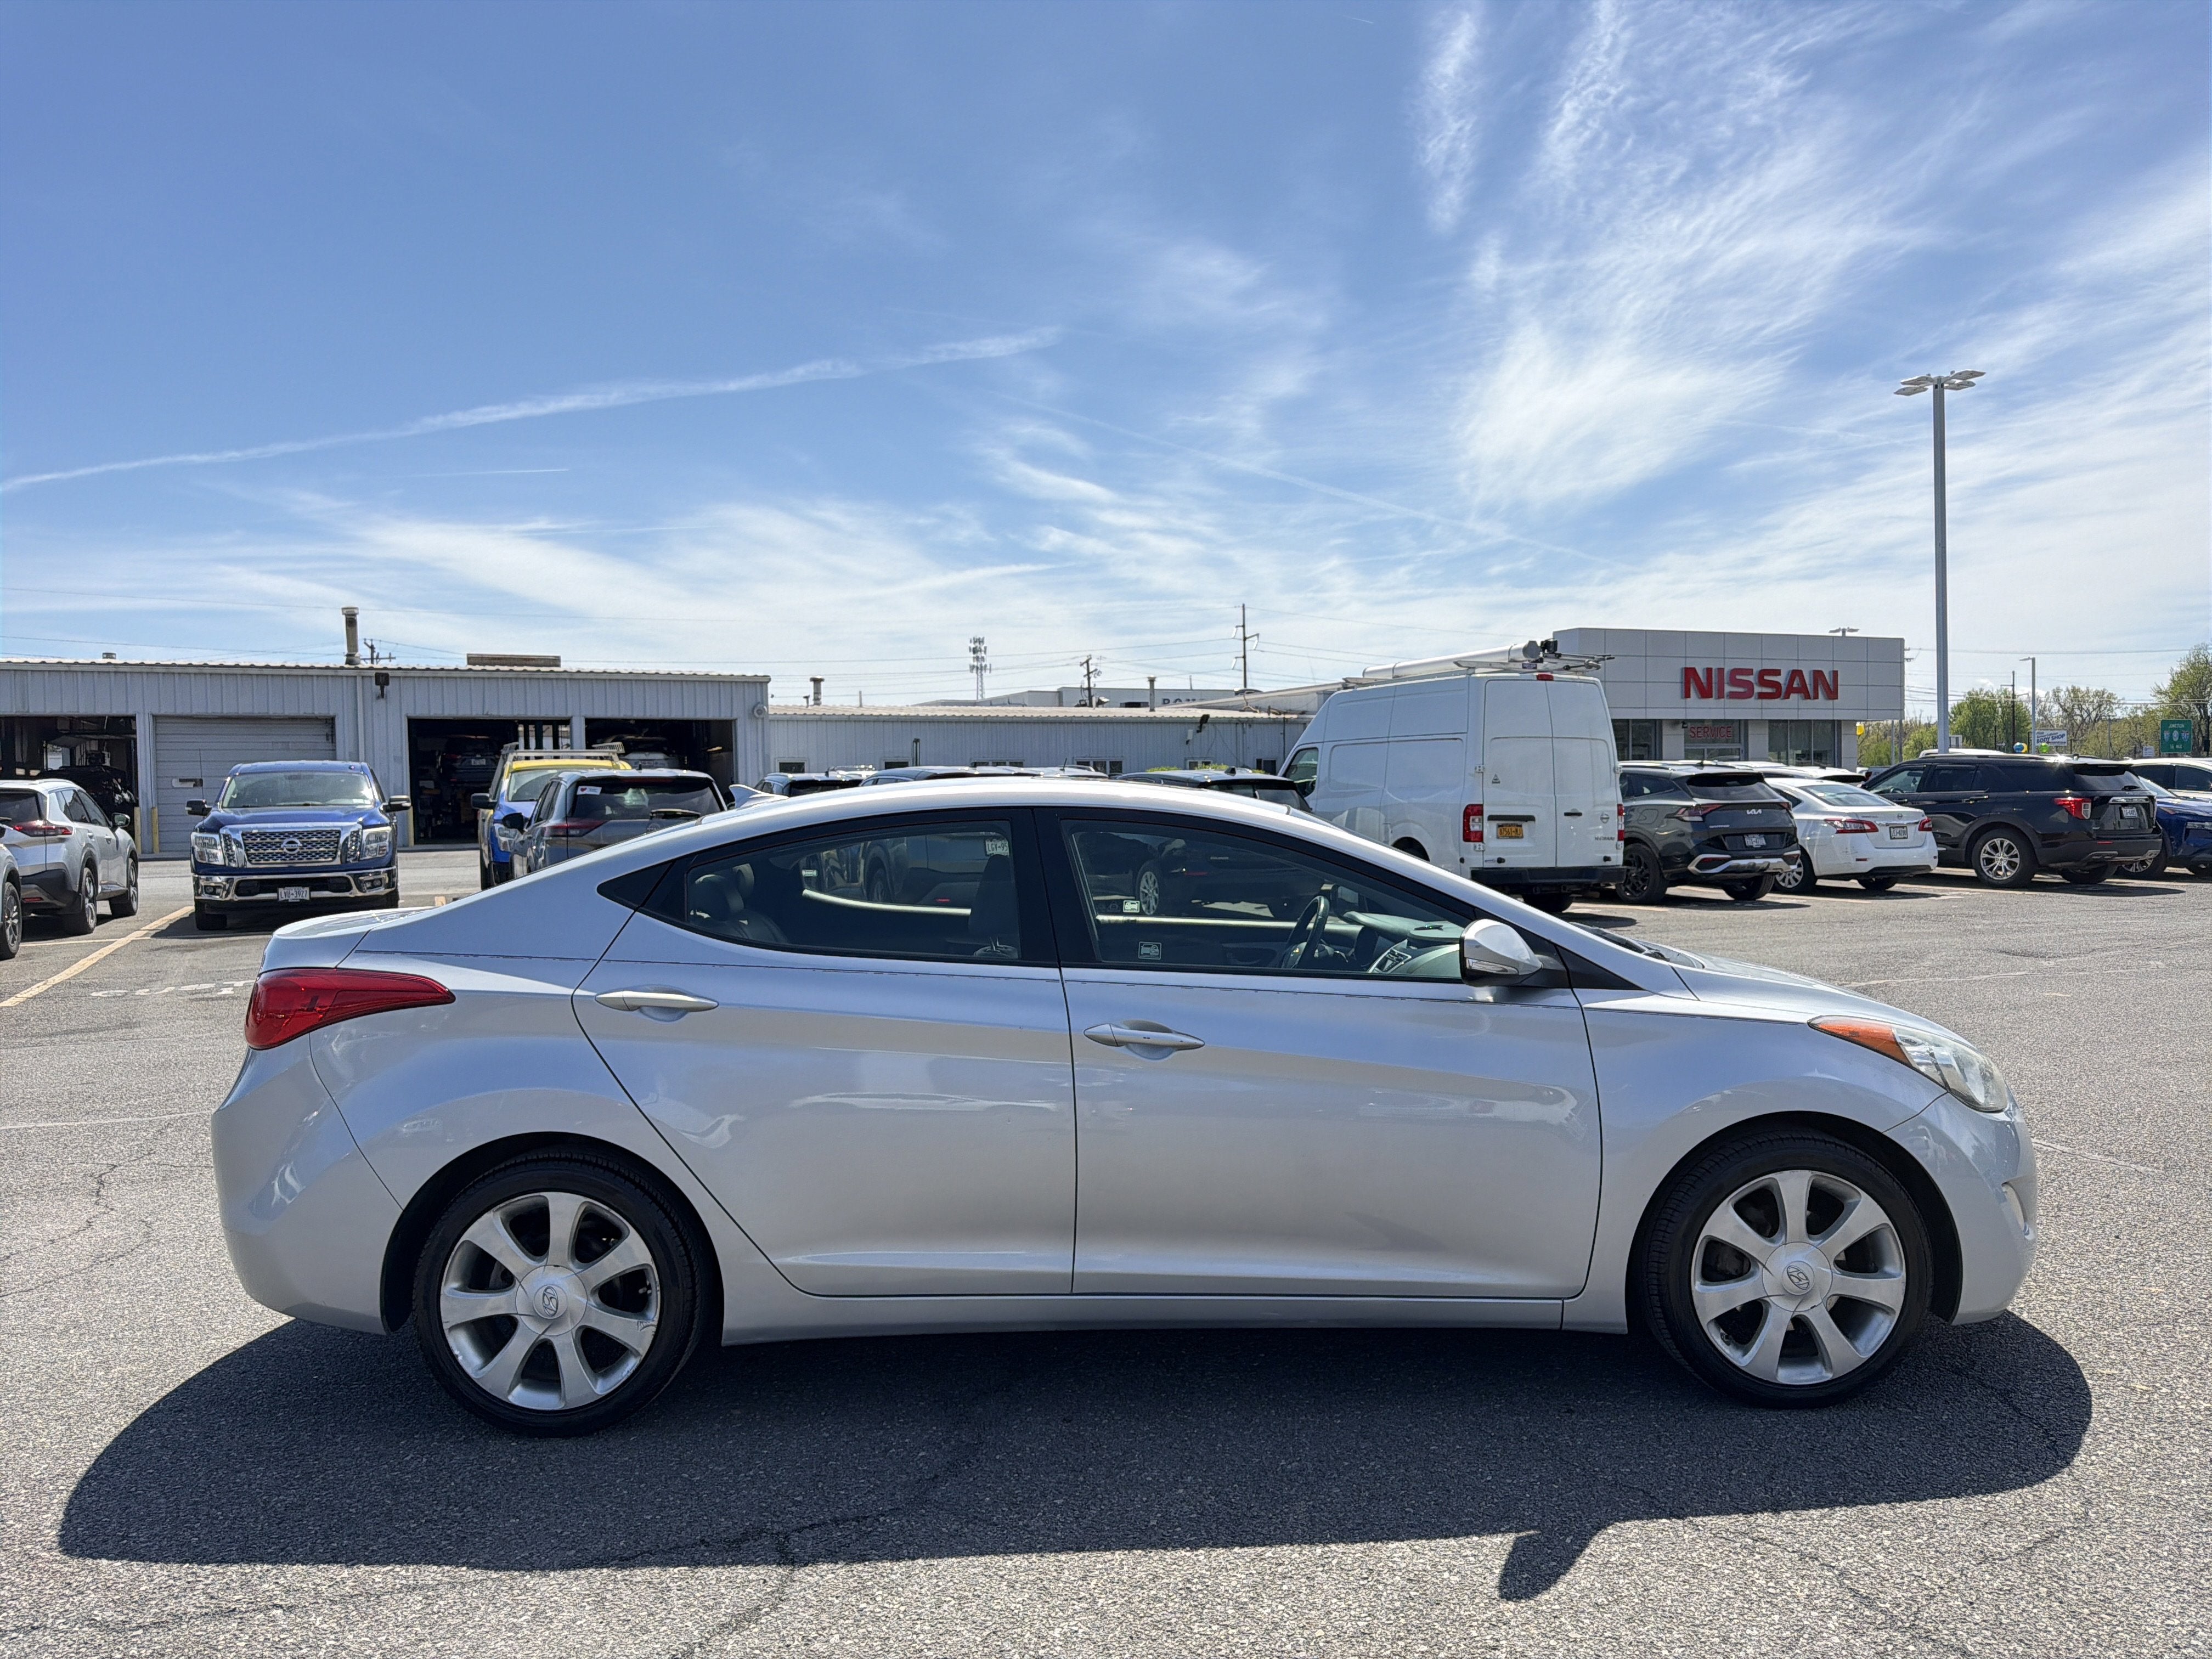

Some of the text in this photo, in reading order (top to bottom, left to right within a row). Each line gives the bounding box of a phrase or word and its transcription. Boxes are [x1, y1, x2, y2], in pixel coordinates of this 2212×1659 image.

[1681, 667, 1838, 700] NISSAN
[1689, 726, 1732, 738] SERVICE
[280, 890, 308, 899] LVU-3927
